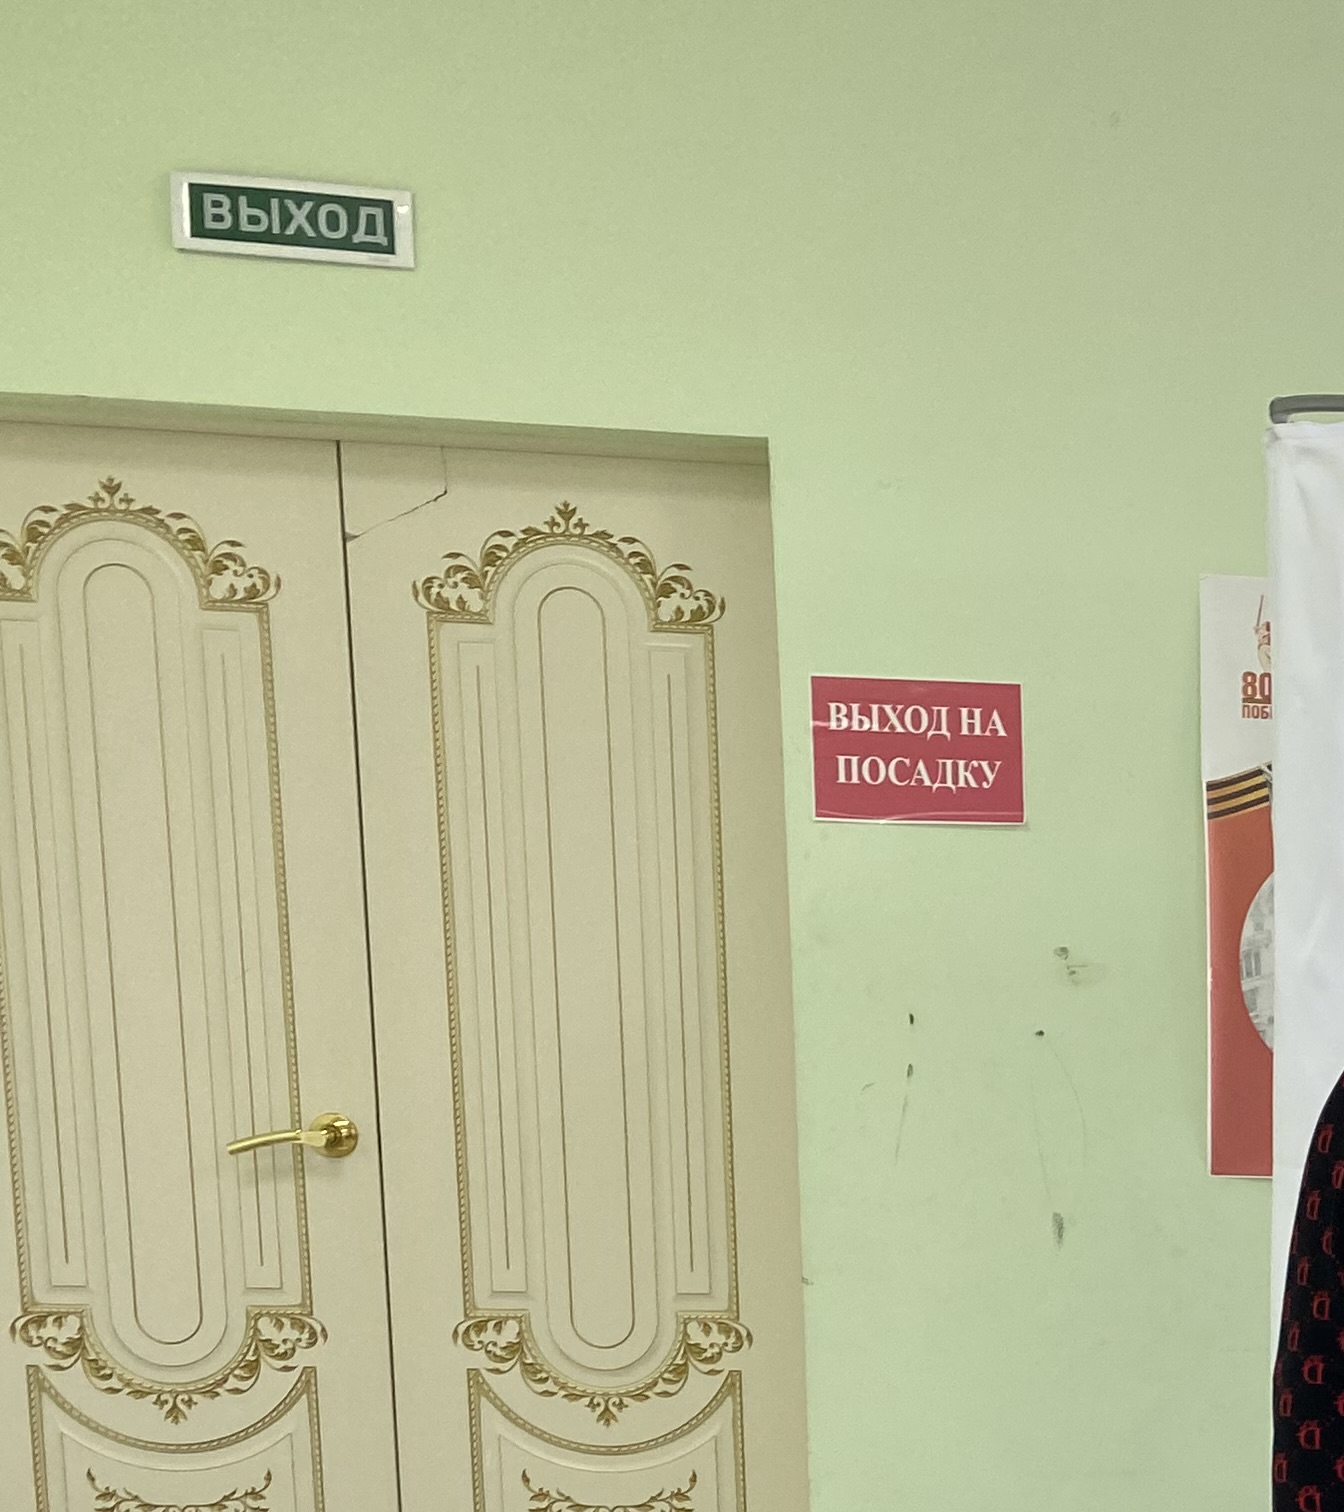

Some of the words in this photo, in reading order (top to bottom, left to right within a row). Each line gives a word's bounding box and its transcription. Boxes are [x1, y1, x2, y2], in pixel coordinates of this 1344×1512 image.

[202, 192, 388, 247] ВЫХОД
[827, 702, 951, 742] ВЫХОД
[958, 706, 1008, 737] НА
[1241, 705, 1273, 719] ПОБ
[835, 754, 1003, 794] ПОСАДКУ
